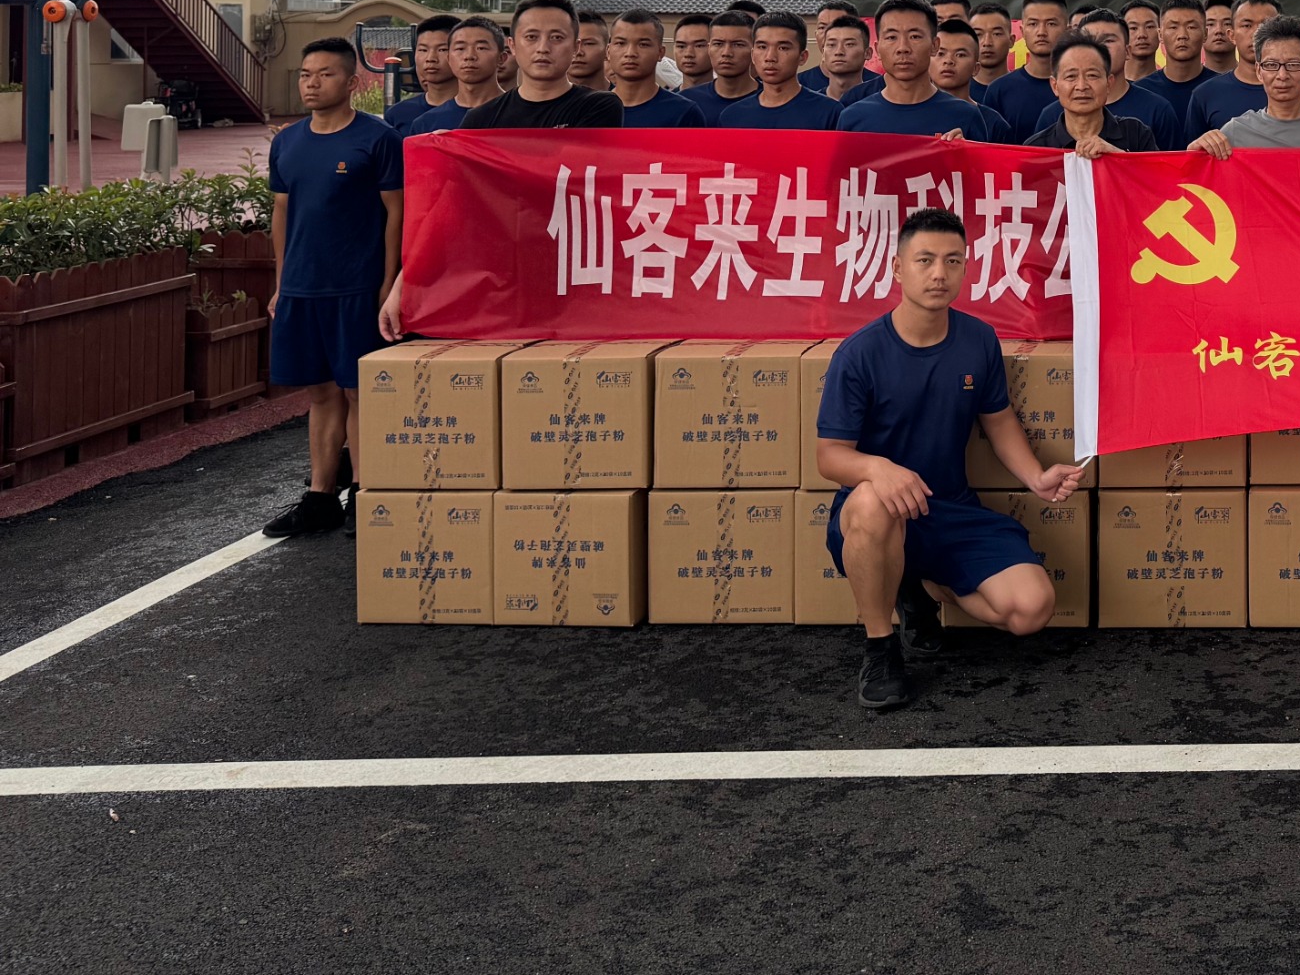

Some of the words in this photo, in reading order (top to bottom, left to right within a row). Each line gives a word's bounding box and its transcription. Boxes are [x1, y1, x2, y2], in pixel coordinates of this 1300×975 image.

[549, 413, 607, 426] 仙客来牌
[702, 413, 760, 425] 仙客来牌
[385, 432, 476, 445] 破壁灵芝孢子粉
[530, 429, 625, 443] 破壁灵芝孢子粉
[400, 550, 455, 563] 仙客来牌
[696, 548, 754, 562] 仙客来牌
[1146, 549, 1205, 563] 仙客来牌
[1127, 566, 1224, 580] 破壁灵芝孢子粉
